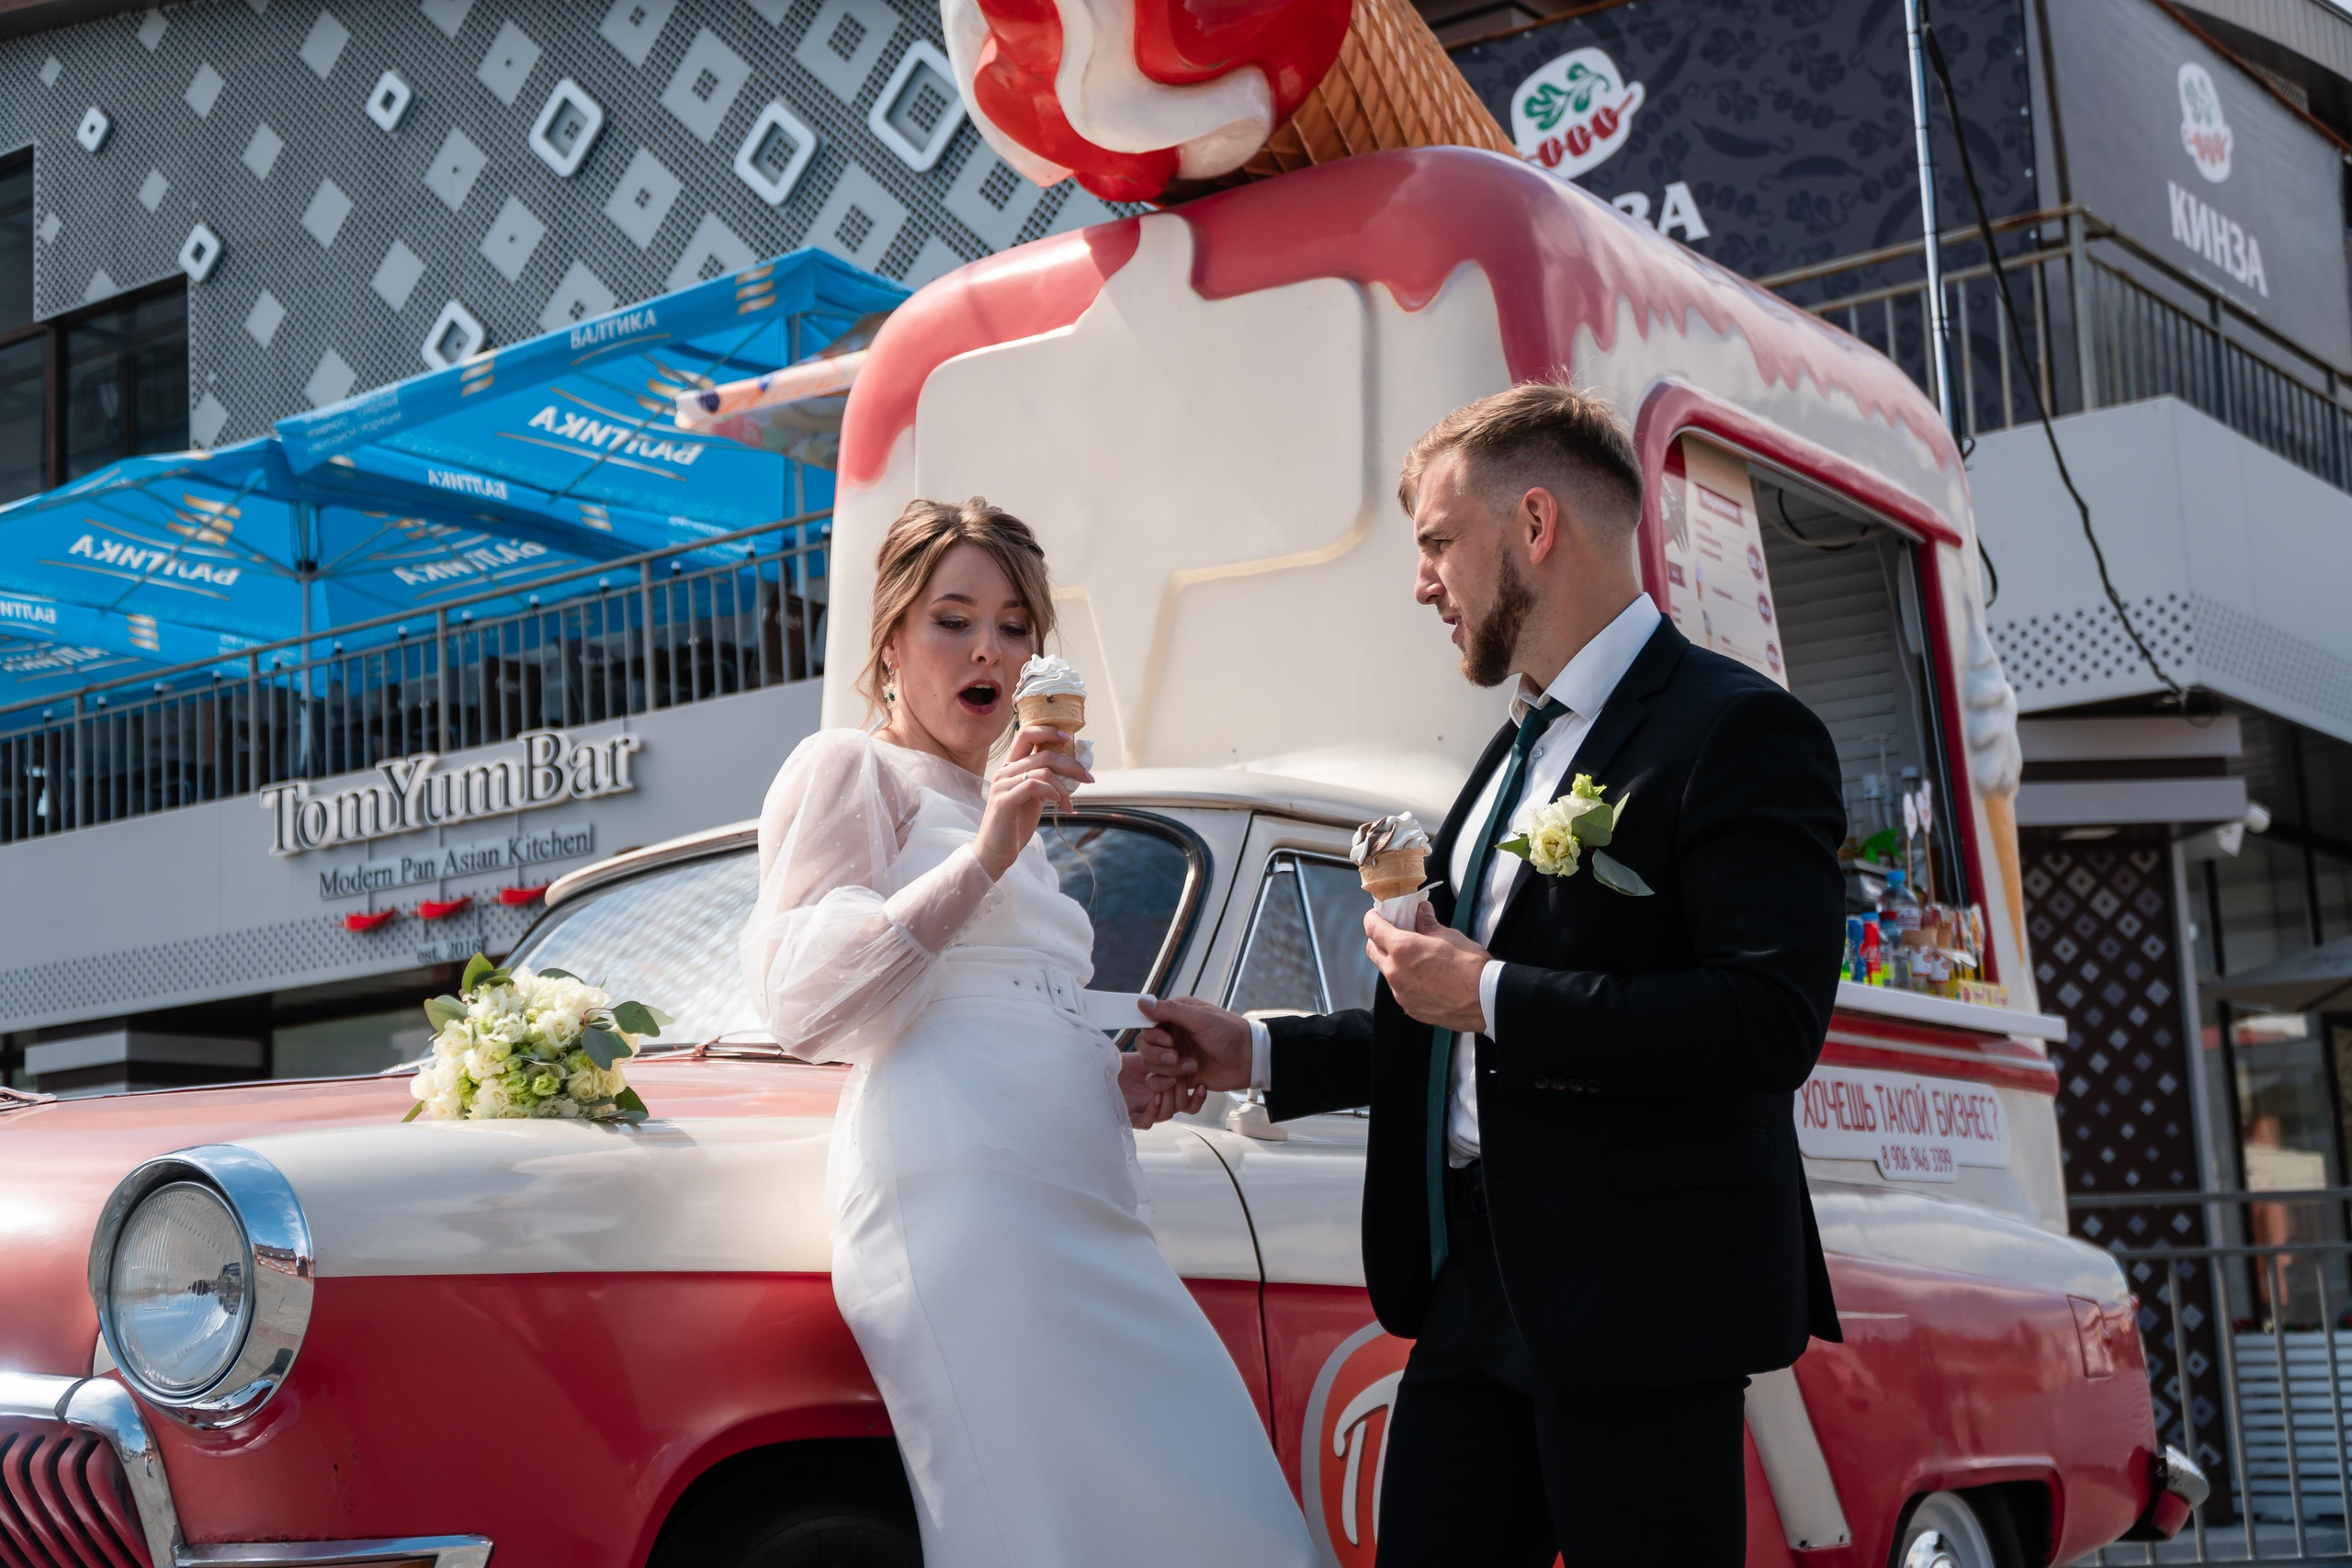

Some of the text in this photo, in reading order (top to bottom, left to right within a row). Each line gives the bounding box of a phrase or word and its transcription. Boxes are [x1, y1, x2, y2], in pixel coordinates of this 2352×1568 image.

[2167, 178, 2269, 299] КИНЗА
[570, 308, 657, 350] БАЛТИКА
[259, 728, 640, 855] TomYumBar
[320, 829, 590, 899] Modern Pan Asian Kitchen
[1801, 1079, 2001, 1142] ХОЧЕШЬ ТАКОЙ БИЗНЕС?
[1881, 1145, 1890, 1170] 8
[1890, 1145, 1911, 1171] 906
